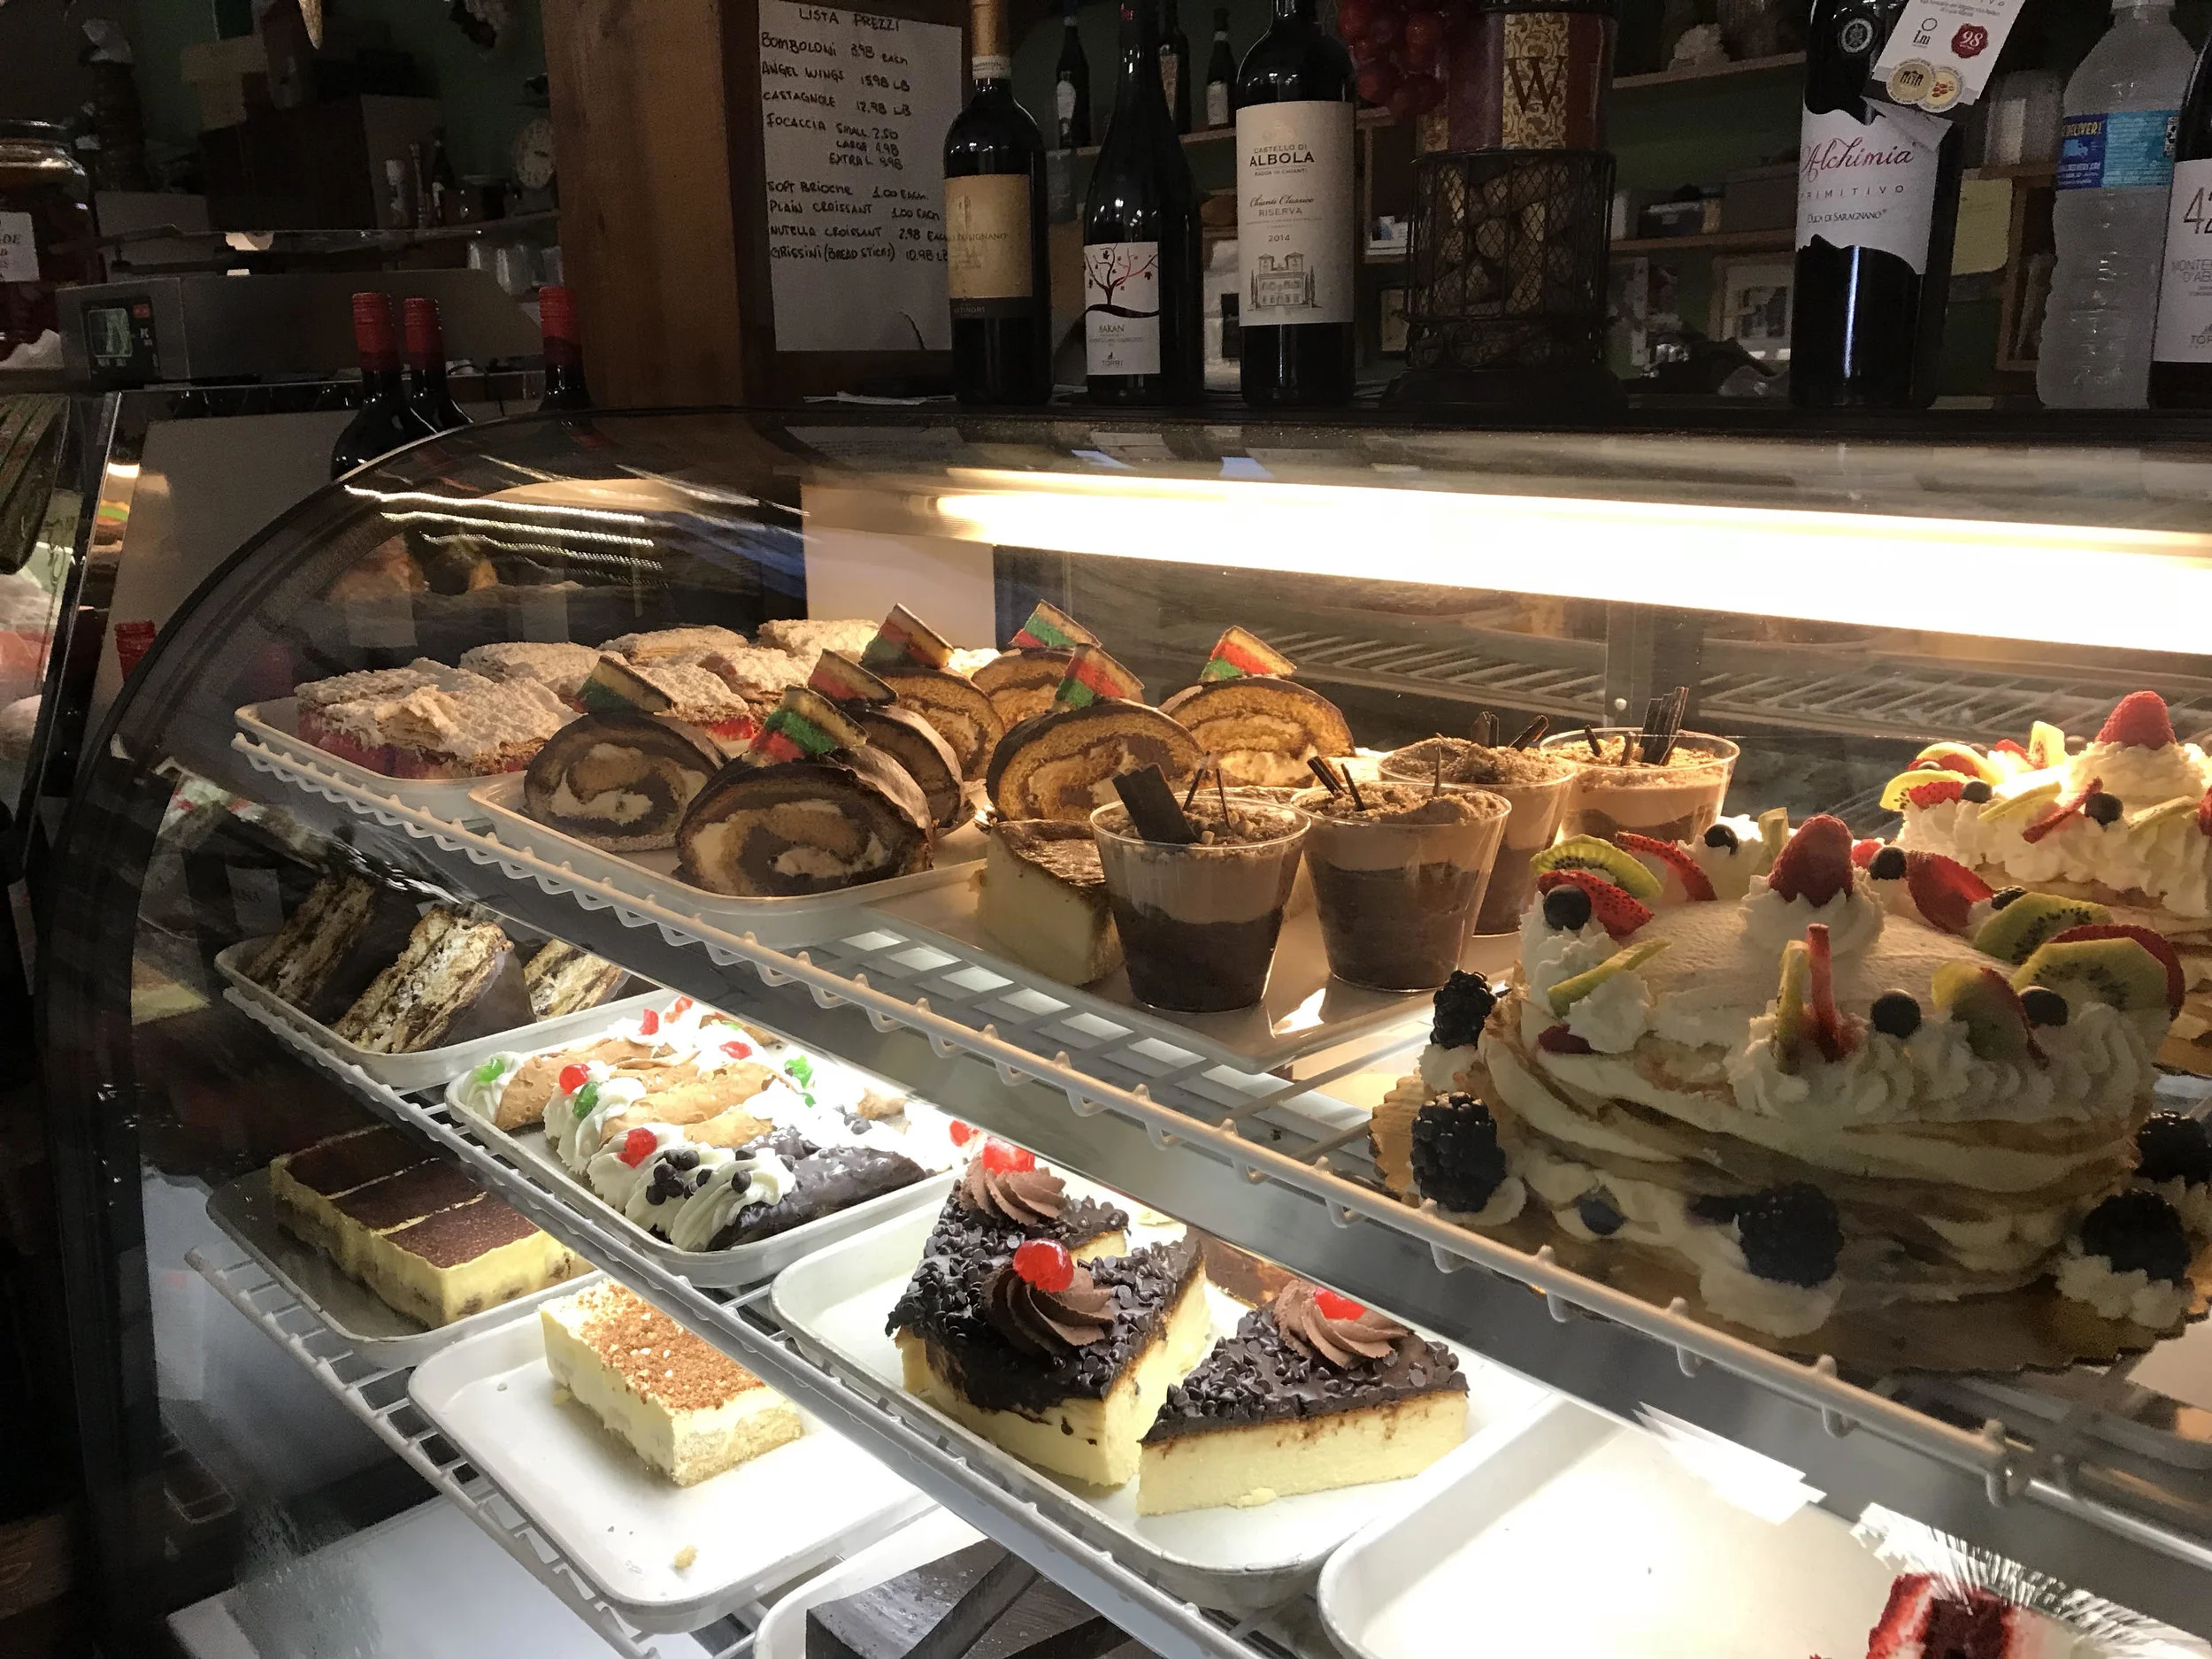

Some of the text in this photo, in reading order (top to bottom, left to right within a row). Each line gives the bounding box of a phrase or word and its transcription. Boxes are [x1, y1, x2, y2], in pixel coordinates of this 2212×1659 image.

[799, 8, 900, 32] LISTA PREZZI
[761, 32, 837, 56] BOMBOLONI
[762, 60, 798, 78] ANGEL
[806, 66, 845, 83] WINGS
[894, 79, 910, 92] LB
[763, 91, 836, 108] CASTAGNOLE
[894, 104, 912, 117] LB
[766, 113, 826, 132] FOCACCIA
[1254, 144, 1295, 154] CASTELLO
[829, 152, 863, 166] EXTRA
[1249, 151, 1315, 167] ALBOLA
[1801, 136, 1914, 183] Alchimia
[768, 180, 795, 194] SOFT
[1799, 185, 1905, 200] PRIMITIVO
[1279, 194, 1315, 205] Classico
[1258, 207, 1303, 217] RISERVA
[770, 225, 817, 238] NUTELLA
[2183, 271, 2212, 283] D'AB
